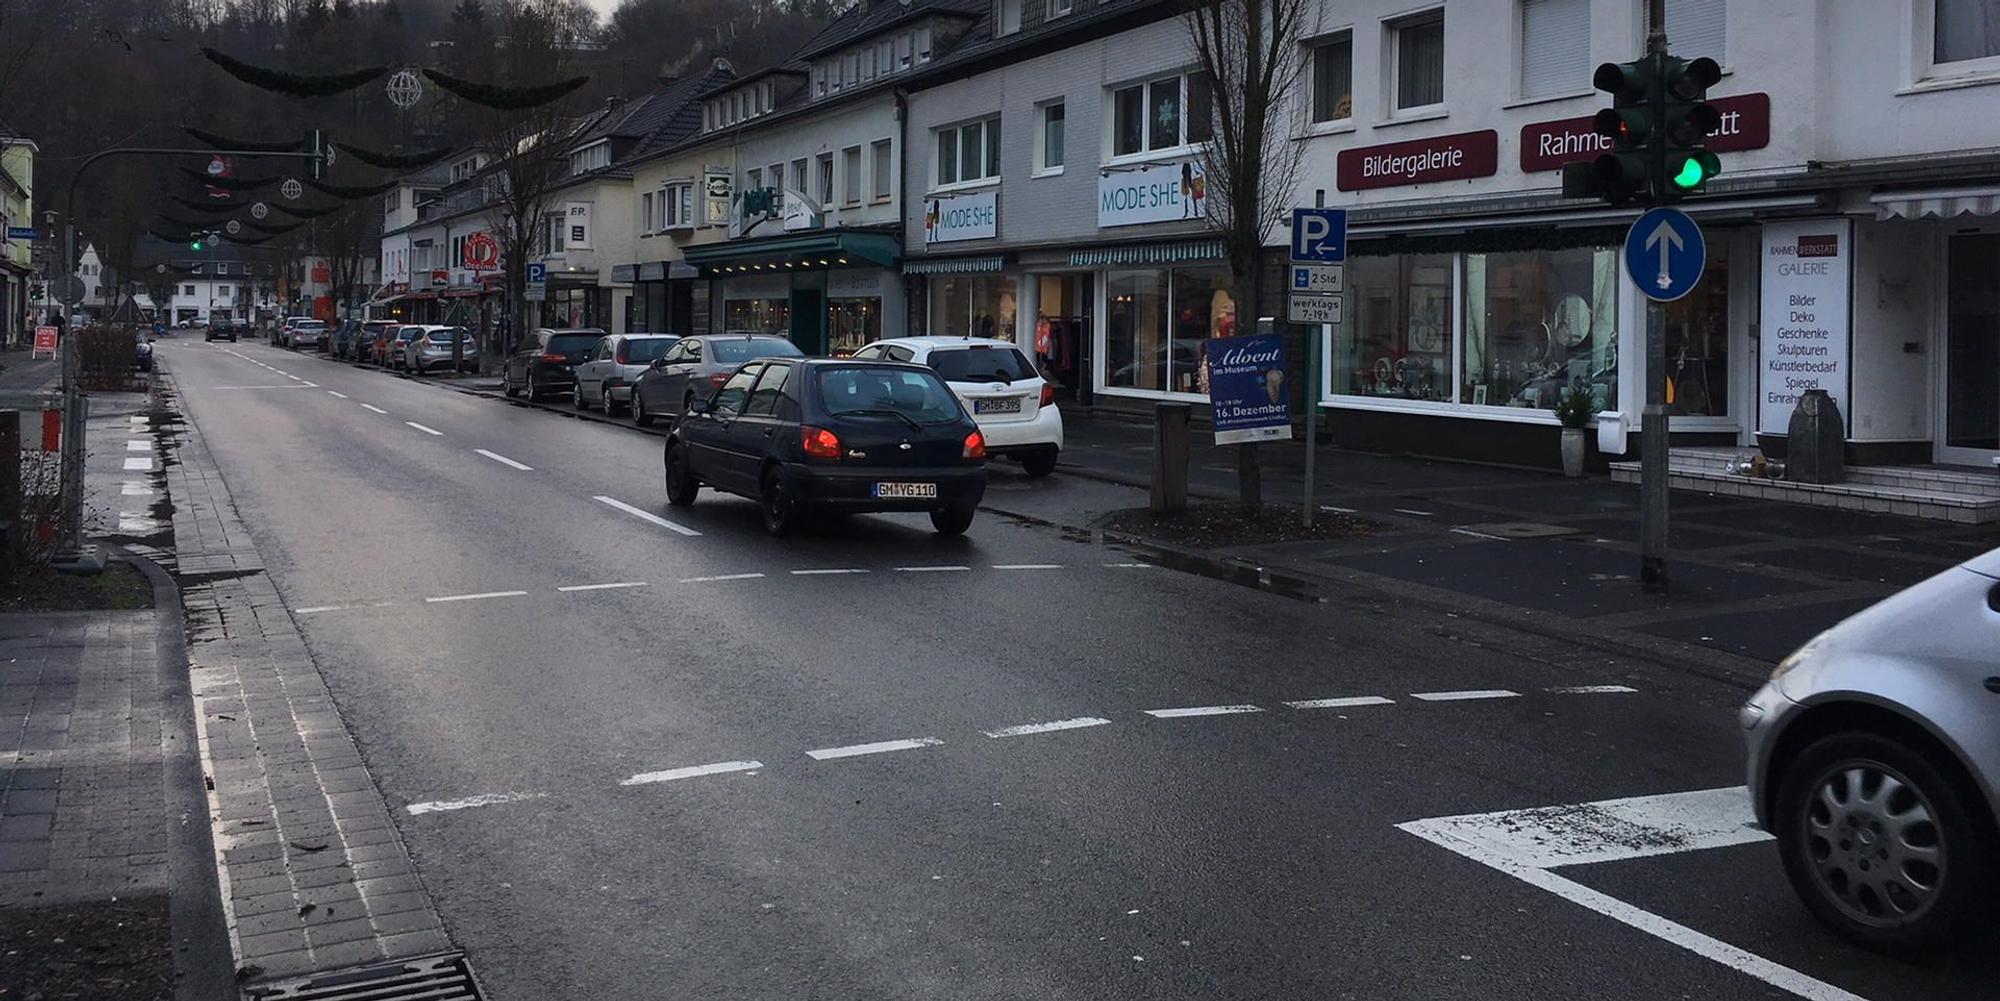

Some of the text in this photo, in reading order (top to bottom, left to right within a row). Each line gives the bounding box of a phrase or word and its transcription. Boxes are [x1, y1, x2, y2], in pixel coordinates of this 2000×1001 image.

[1363, 146, 1463, 178] Bildergalerie
[1102, 181, 1179, 212] MODE SHE
[941, 205, 993, 229] MODE SHE
[1300, 215, 1330, 255] P
[530, 266, 542, 281] P
[1778, 262, 1829, 276] GALERIE
[1312, 274, 1318, 284] 2
[1292, 299, 1339, 311] werktags
[1789, 294, 1816, 306] Bilder
[1790, 311, 1815, 322] Deko
[1777, 327, 1829, 339] Geschenke
[1778, 344, 1828, 358] Skulpturen
[1209, 348, 1280, 368] Advent
[1224, 365, 1258, 375] Museum
[1769, 360, 1838, 373] Künstlerbedarf
[1785, 377, 1819, 390] Spiegel
[1216, 404, 1288, 419] 16. Dezember
[879, 484, 936, 496] GM YG 110
